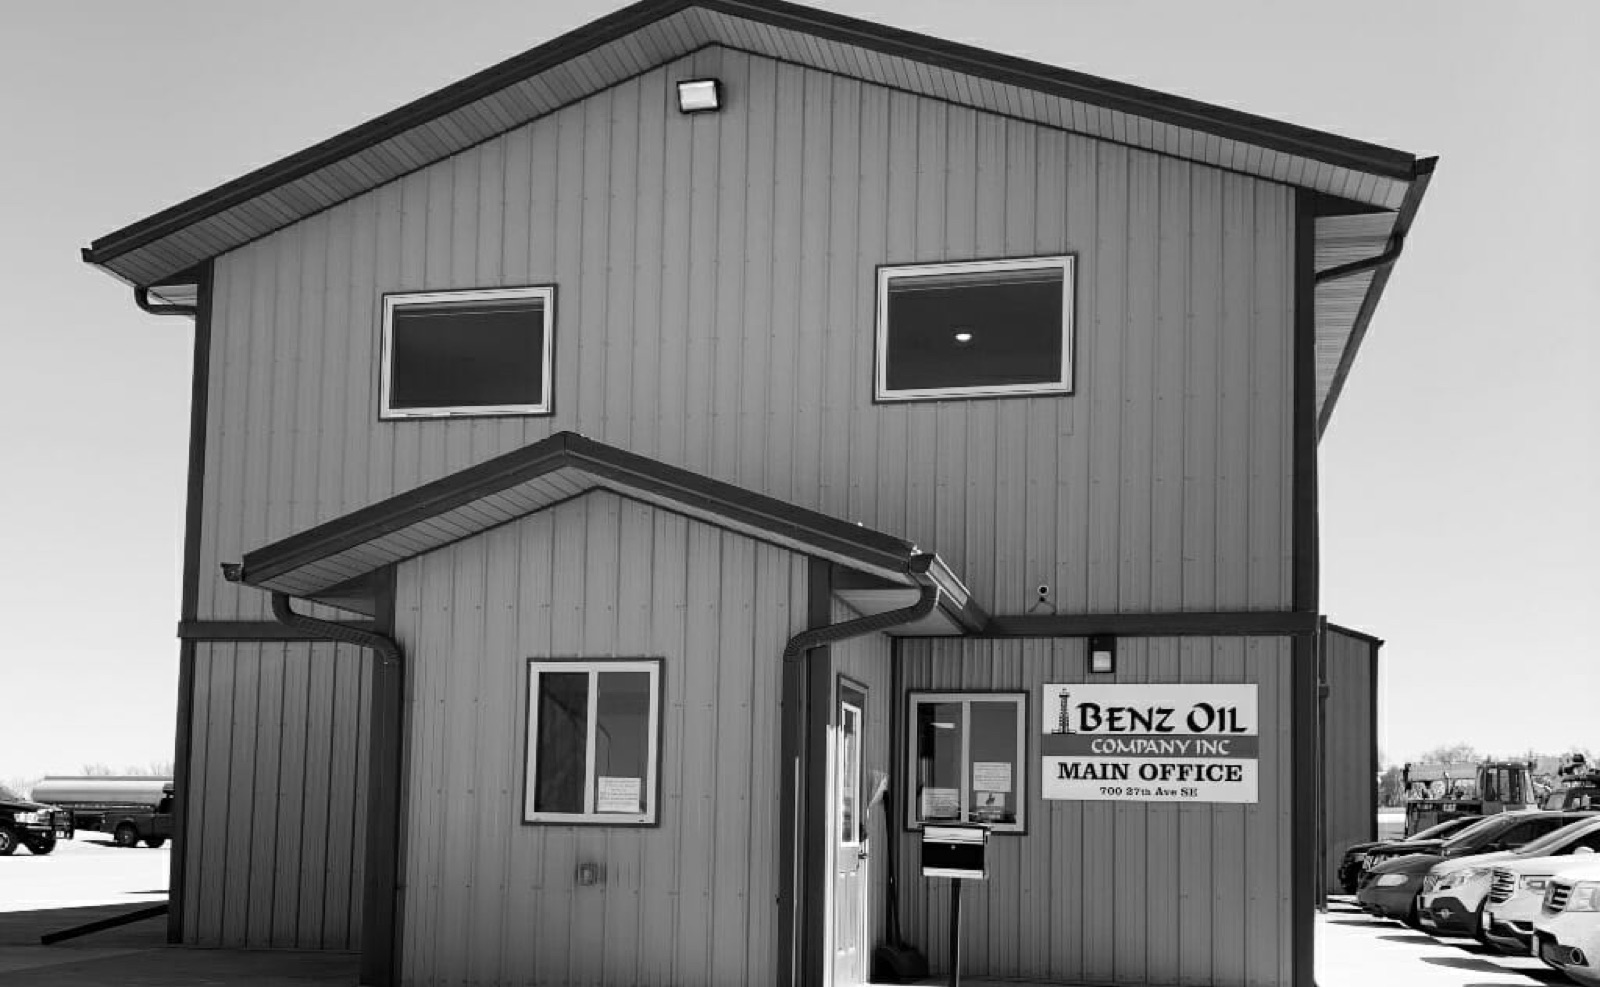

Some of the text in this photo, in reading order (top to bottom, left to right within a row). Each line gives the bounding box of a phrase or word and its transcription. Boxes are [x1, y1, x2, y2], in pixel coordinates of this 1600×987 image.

[1076, 702, 1248, 733] BENZ OIL
[1091, 738, 1231, 755] COMPANY INC
[1057, 762, 1243, 782] MAIN OFFICE
[1100, 786, 1198, 798] 700 27th Ave SE
